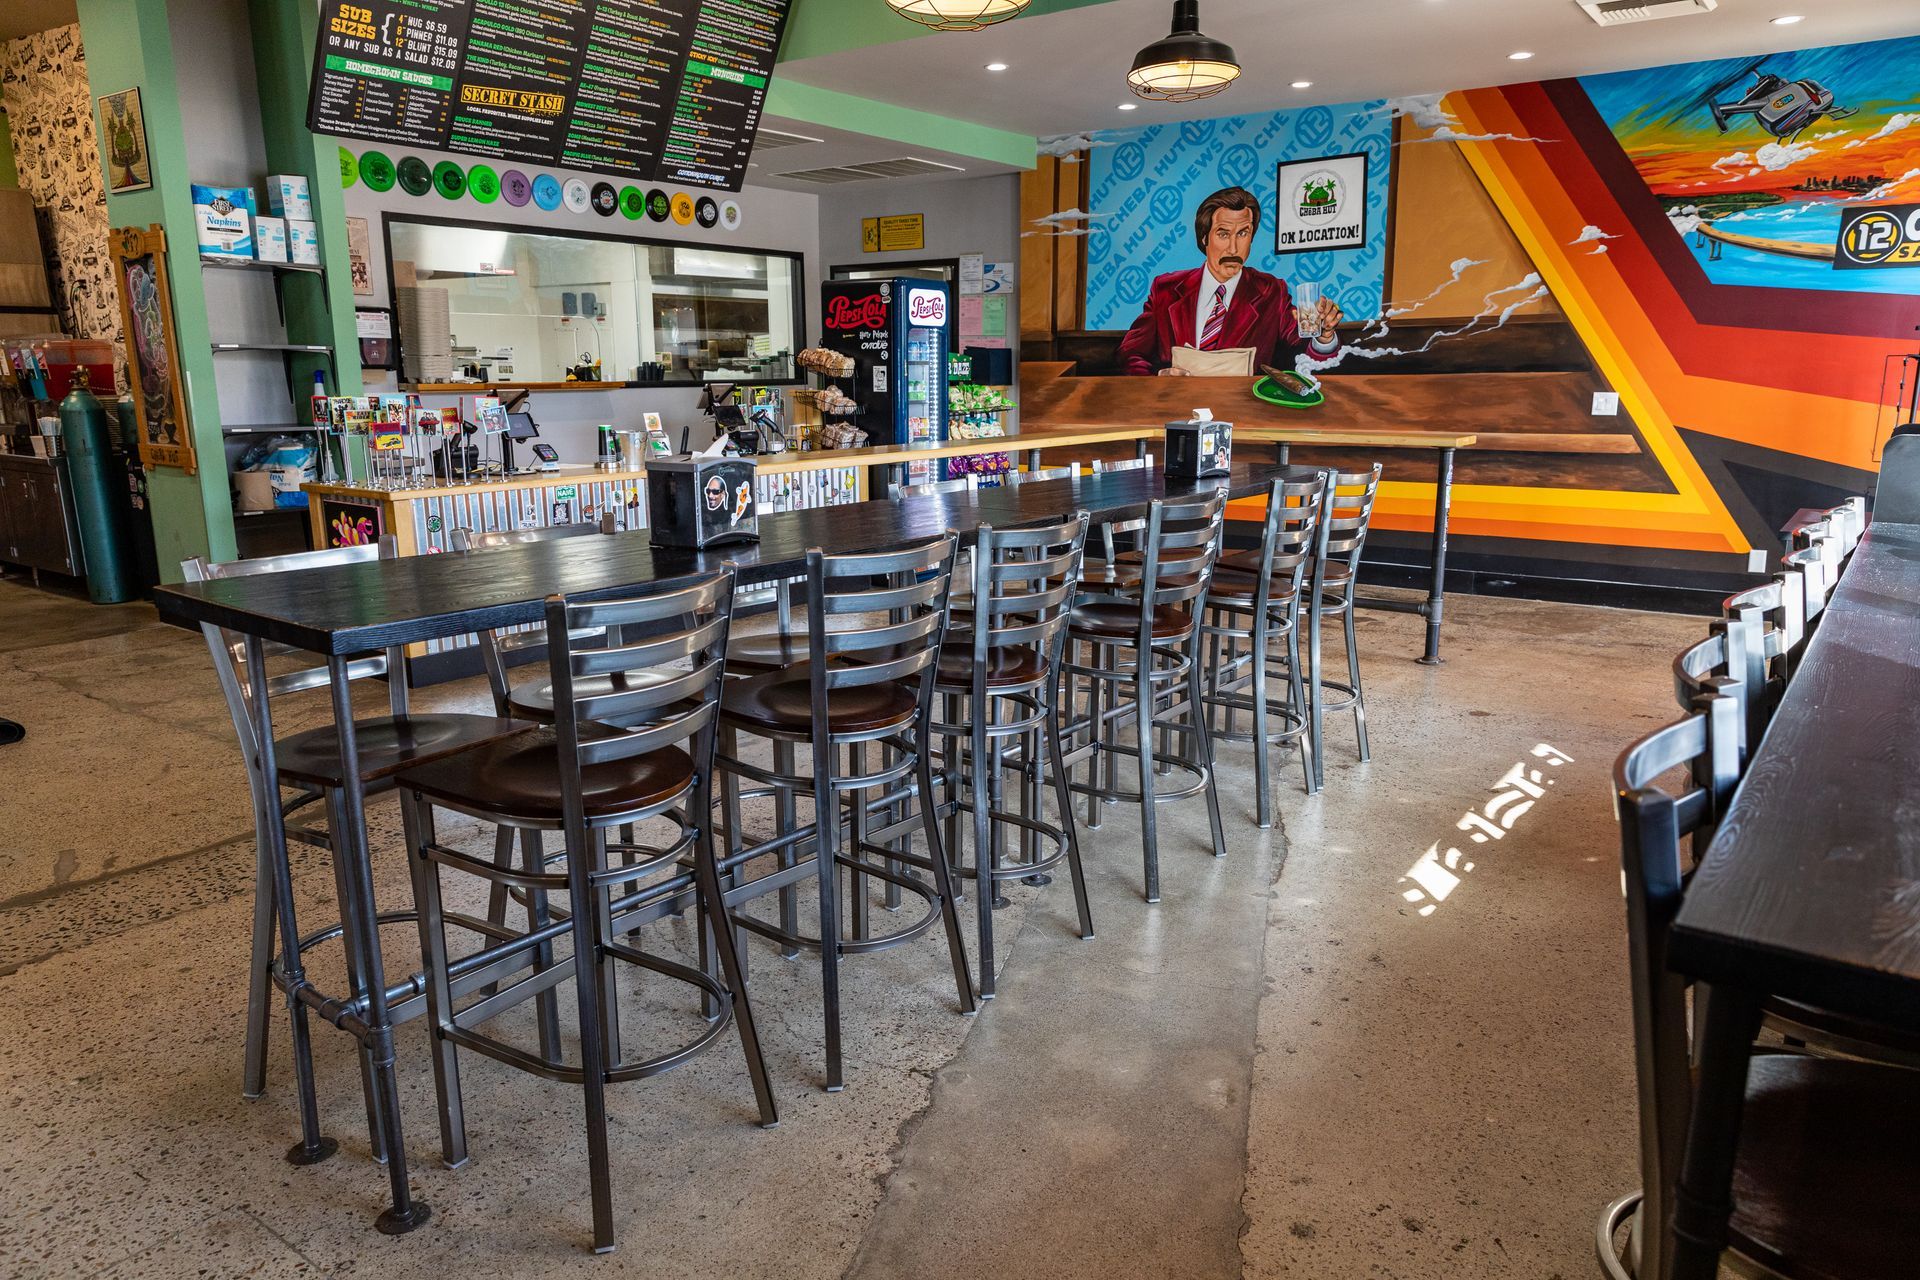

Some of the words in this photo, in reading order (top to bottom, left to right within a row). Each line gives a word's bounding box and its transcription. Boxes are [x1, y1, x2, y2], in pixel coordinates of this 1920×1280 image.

[339, 4, 372, 23] SUB
[407, 16, 422, 28] NUG
[425, 20, 447, 33] $6.59
[330, 18, 376, 39] SIZES
[406, 28, 432, 41] PINNER
[435, 34, 457, 47] $11.09
[329, 35, 340, 46] OR
[344, 38, 360, 50] ANY
[363, 42, 379, 54] SUB
[382, 46, 392, 57] AS
[396, 49, 401, 58] A
[404, 51, 428, 64] SALAD
[430, 56, 455, 69] $12.09
[407, 40, 431, 53] BLUNT
[433, 45, 457, 58] $15.09
[345, 61, 400, 78] HOMEGROWN
[402, 72, 433, 84] SAUCES
[710, 67, 744, 82] MUNCHIES
[463, 87, 516, 105] SECRET
[520, 93, 562, 110] STASH
[482, 109, 506, 117] FAVORITES,
[1295, 105, 1334, 148] 12
[1112, 142, 1144, 180] 12
[1217, 144, 1260, 189] 12
[1108, 177, 1158, 232] CHEBA
[1154, 138, 1186, 176] HUT
[1322, 204, 1337, 214] HUT
[206, 215, 242, 227] Napkins
[1086, 252, 1127, 304] HEBA
[1124, 216, 1154, 254] HUT
[1150, 186, 1184, 224] 12
[1177, 138, 1224, 192] NEWS
[1281, 232, 1296, 244] ON
[1299, 224, 1359, 243] LOCATION!
[1858, 221, 1892, 250] 12
[1091, 295, 1120, 330] HUT
[1116, 265, 1149, 304] 12
[1142, 221, 1187, 274] NEWS
